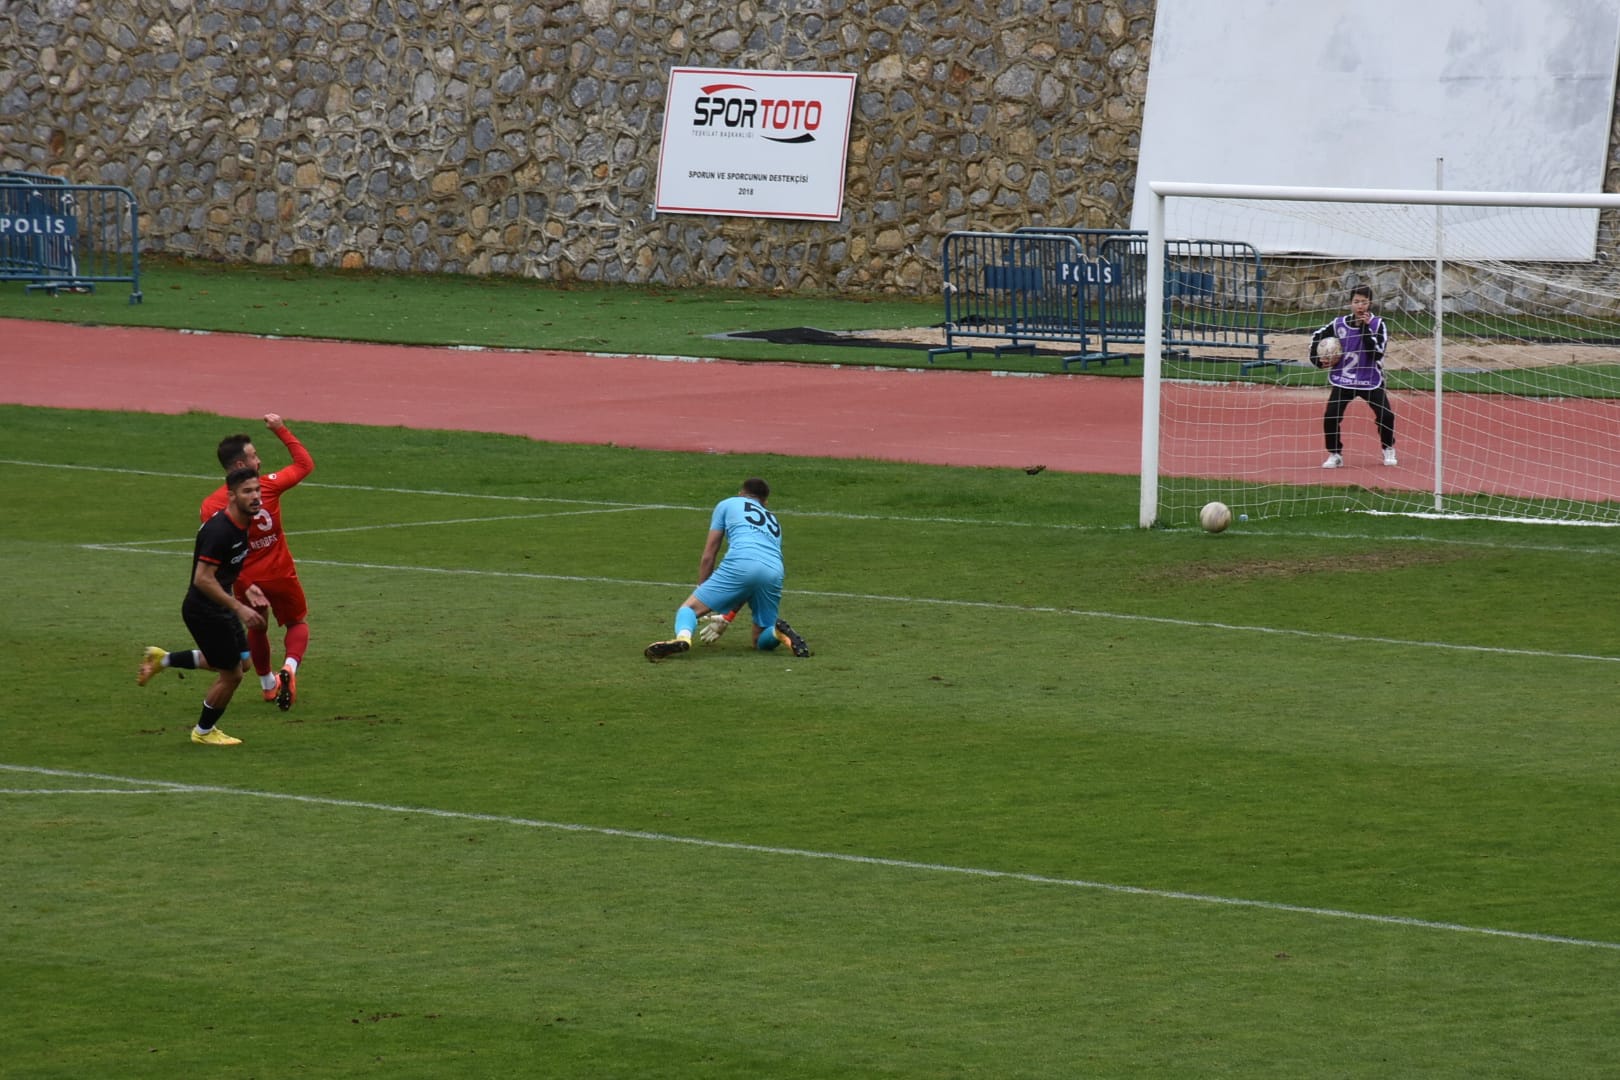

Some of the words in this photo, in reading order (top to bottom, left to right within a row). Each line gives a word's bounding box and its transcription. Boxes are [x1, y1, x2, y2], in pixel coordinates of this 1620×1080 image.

[688, 170, 715, 179] SPORUN
[717, 172, 726, 180] VE
[727, 172, 768, 182] SPORCUNUN
[738, 187, 754, 196] 2018
[0, 215, 65, 234] POLİS
[1342, 351, 1359, 379] 2
